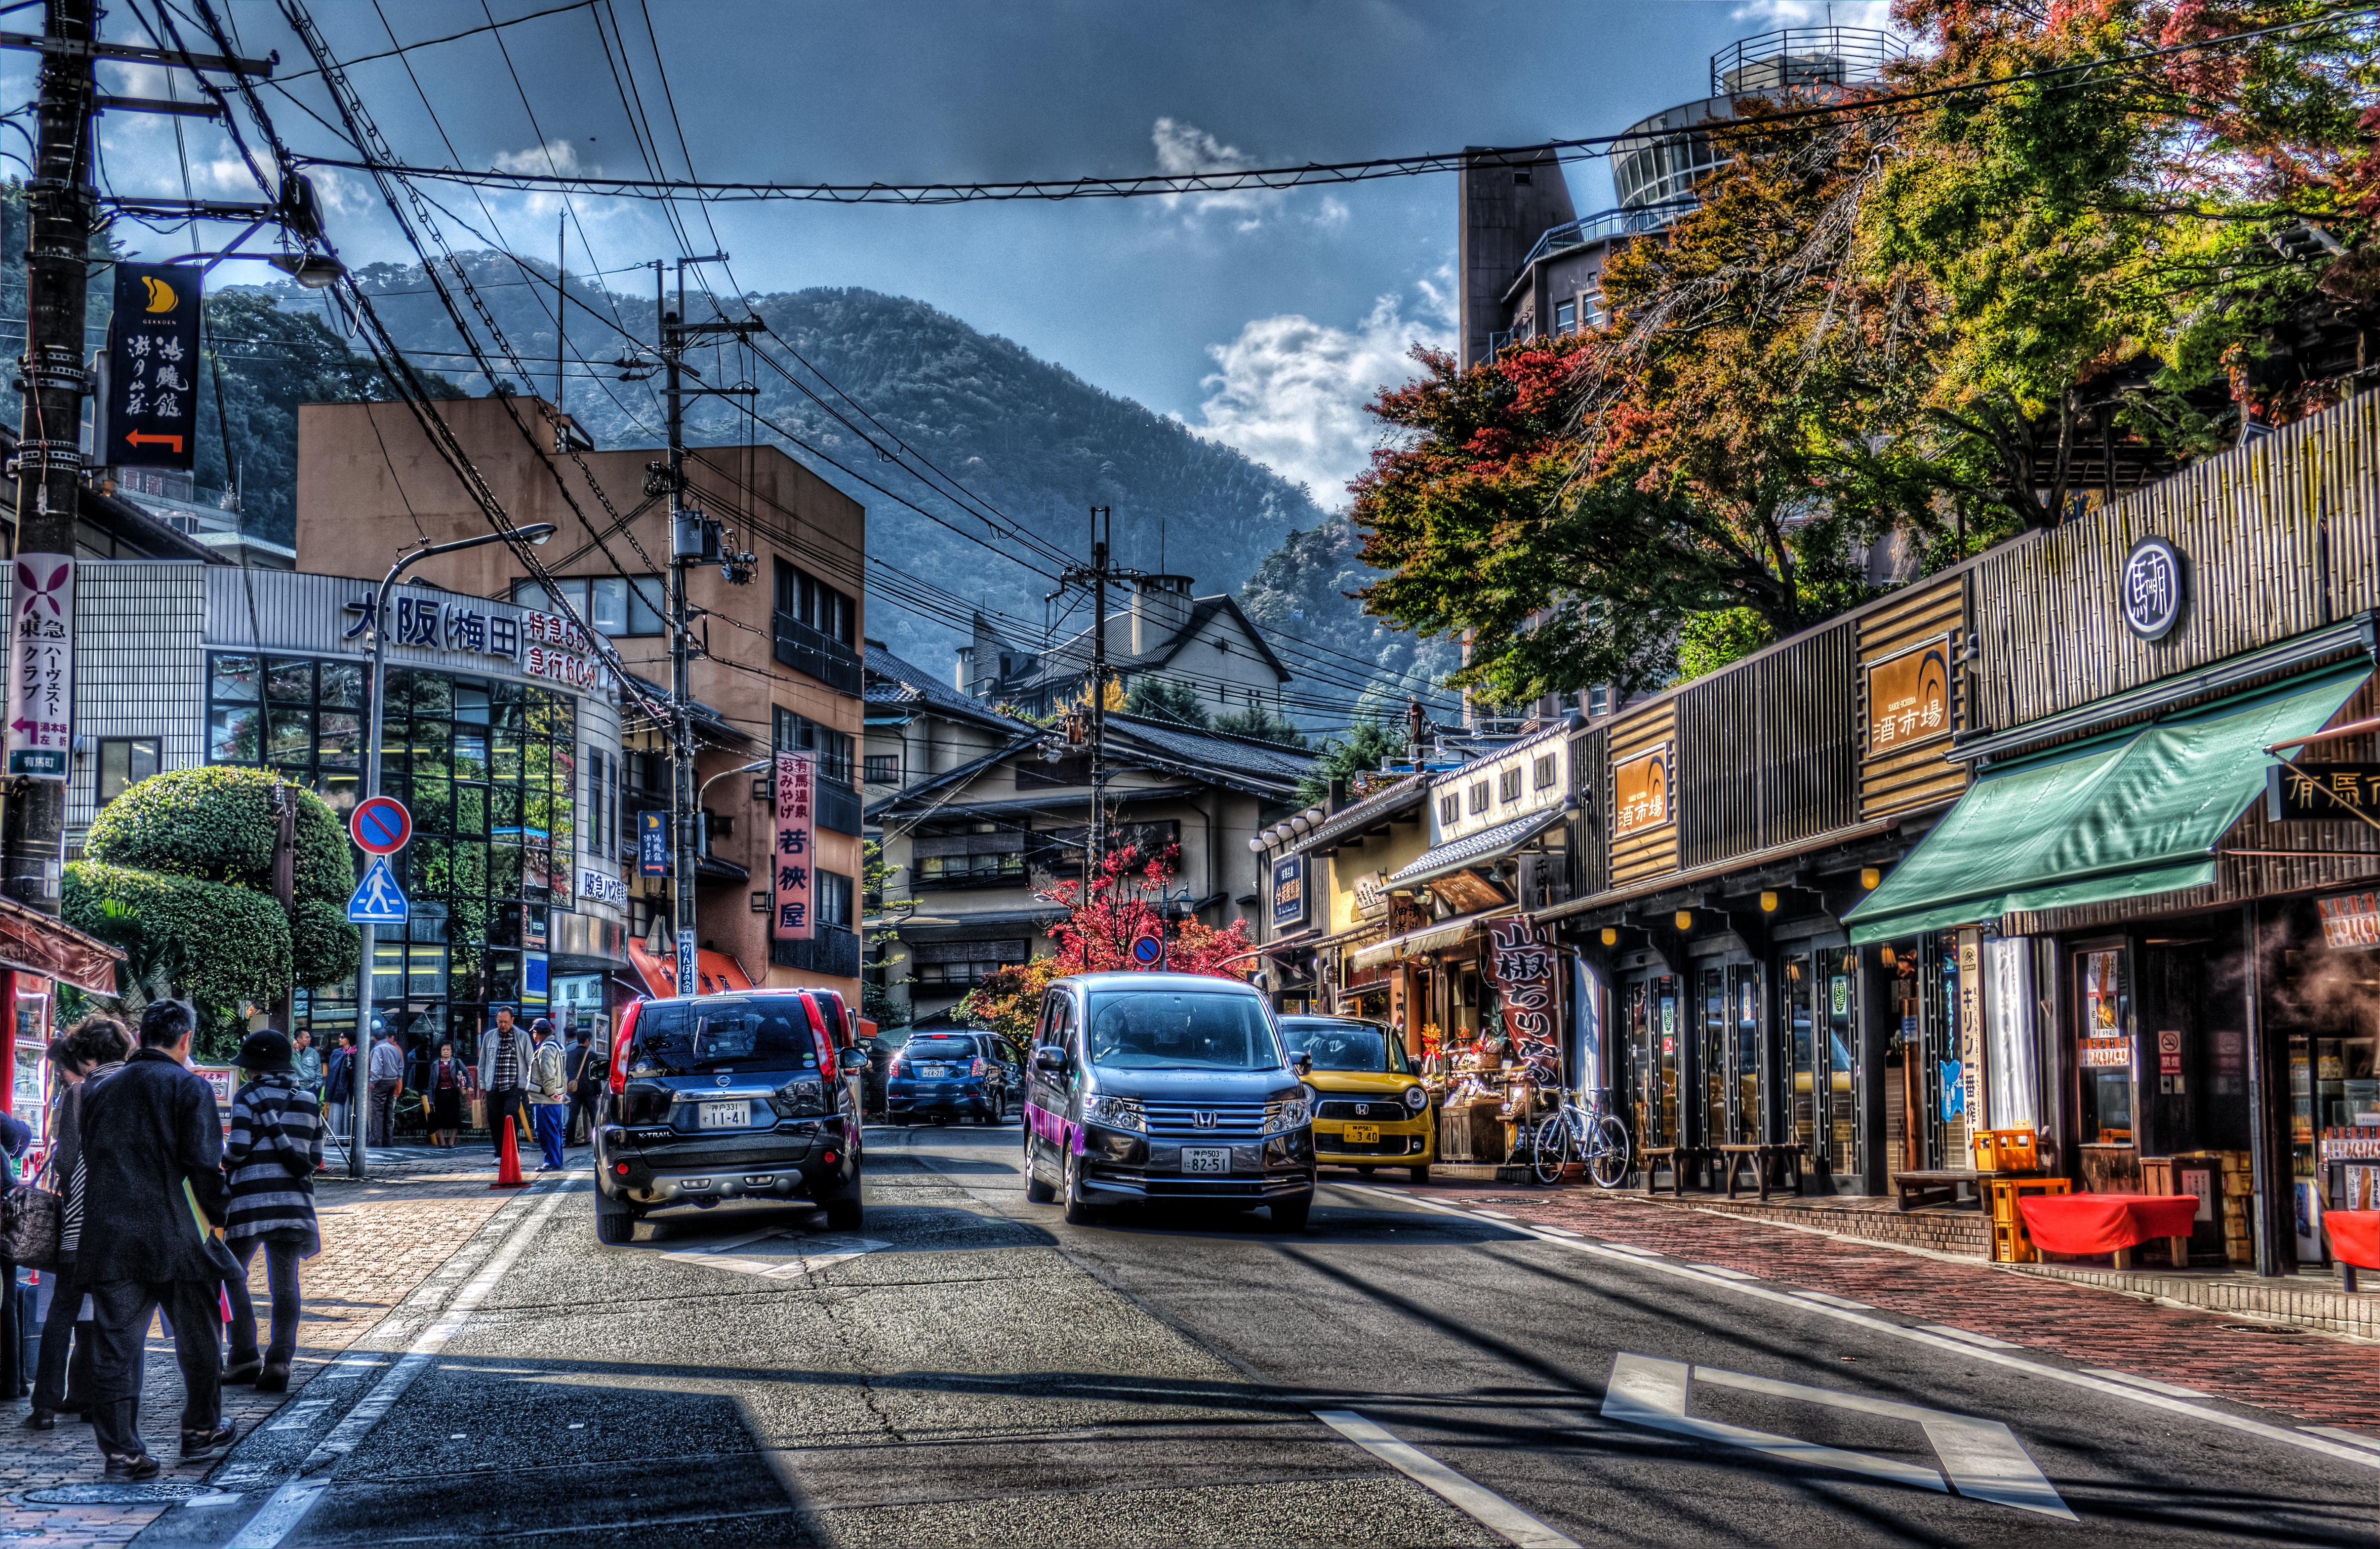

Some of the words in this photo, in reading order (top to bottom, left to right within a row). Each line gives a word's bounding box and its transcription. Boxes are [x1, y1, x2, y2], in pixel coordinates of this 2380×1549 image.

[20, 619, 66, 638] 東急
[23, 646, 41, 700] クラブ
[44, 646, 62, 716] ハーヴェスト
[528, 646, 597, 691] 急行60分
[1873, 699, 1943, 743] 酒市場
[1888, 697, 1916, 712] SAKE-ICHIBA
[40, 722, 67, 734] 湯本坂
[24, 756, 54, 768] 有馬町
[779, 759, 795, 819] おみやげ
[795, 759, 808, 818] 有馬温泉
[1618, 794, 1663, 827] 酒市場
[681, 944, 692, 993] かんぽの宿
[713, 1111, 746, 1125] 11-41
[1192, 1158, 1225, 1171] 82-51
